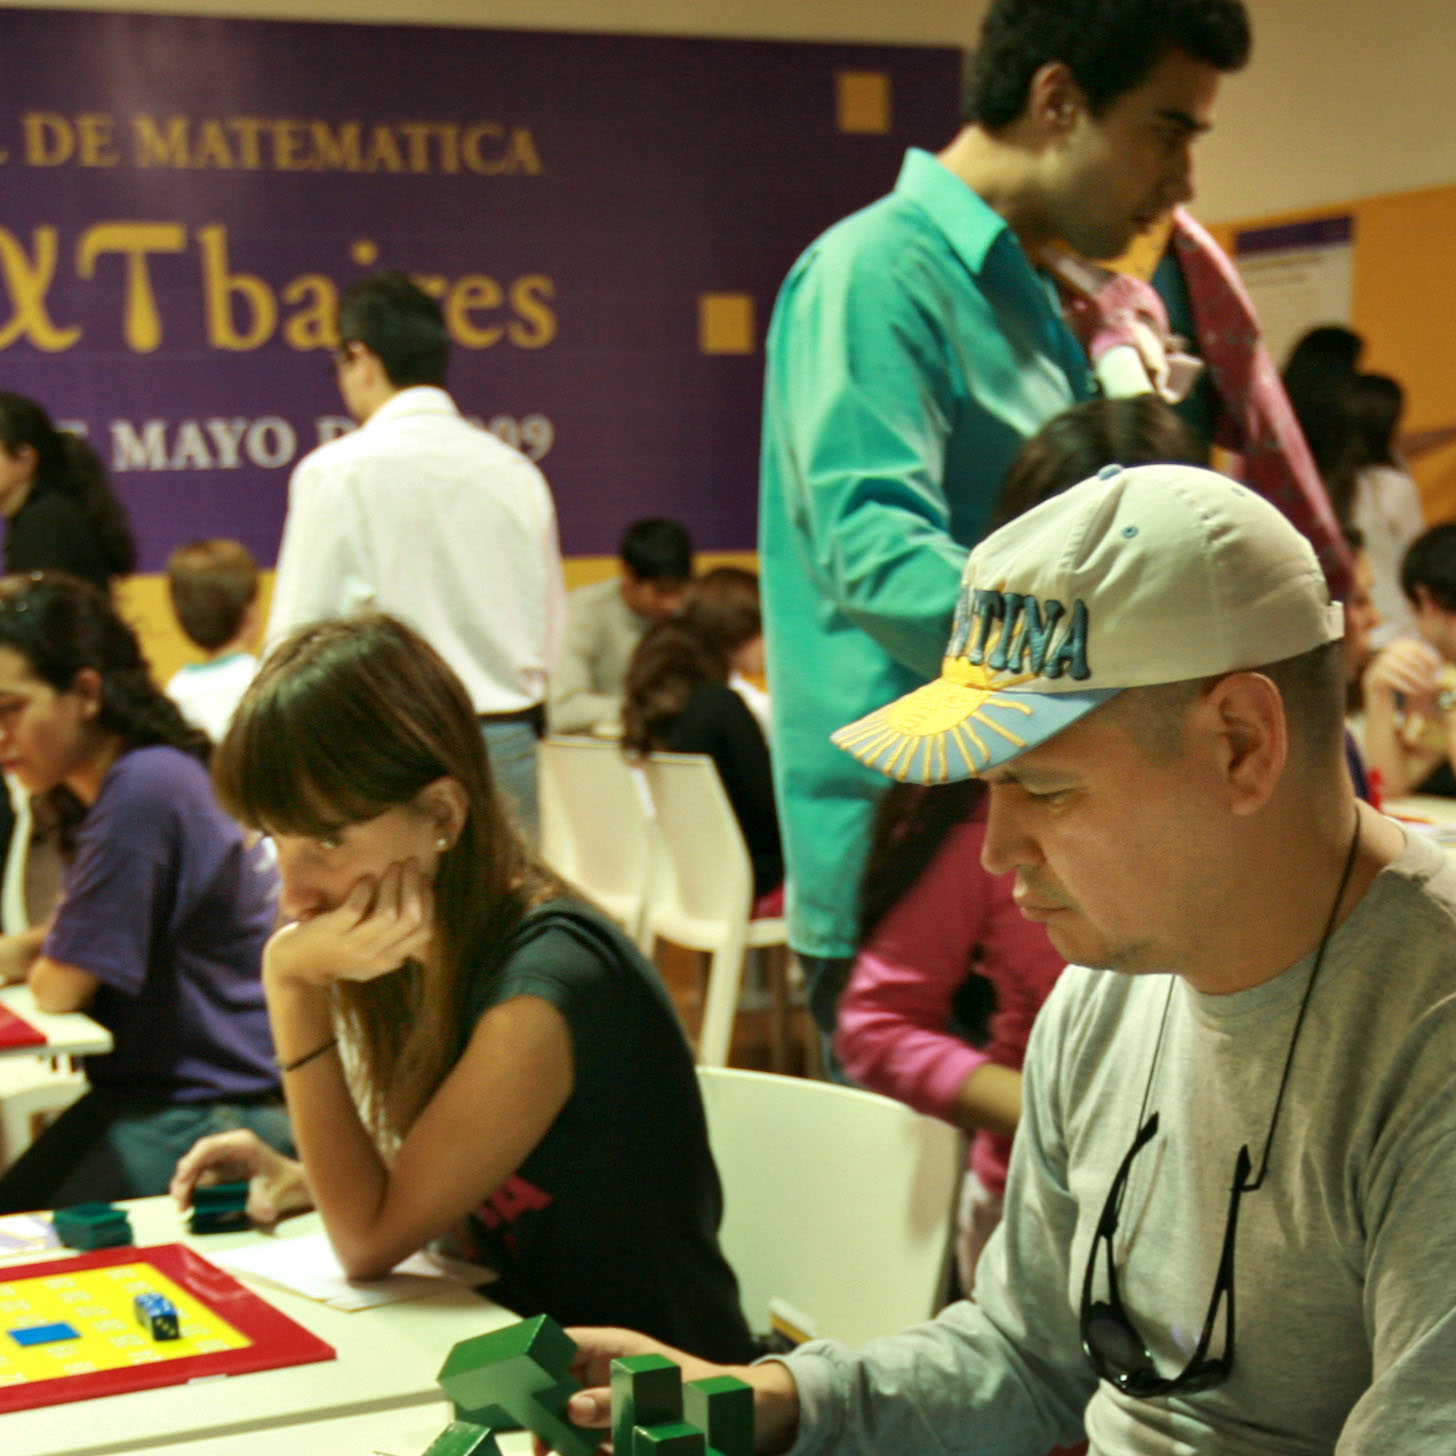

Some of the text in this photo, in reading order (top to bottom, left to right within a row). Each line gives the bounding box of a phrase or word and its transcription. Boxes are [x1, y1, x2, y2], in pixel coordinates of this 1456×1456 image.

[23, 111, 120, 168] DE
[133, 115, 542, 175] MATEMATICA
[110, 415, 298, 472] MAYO
